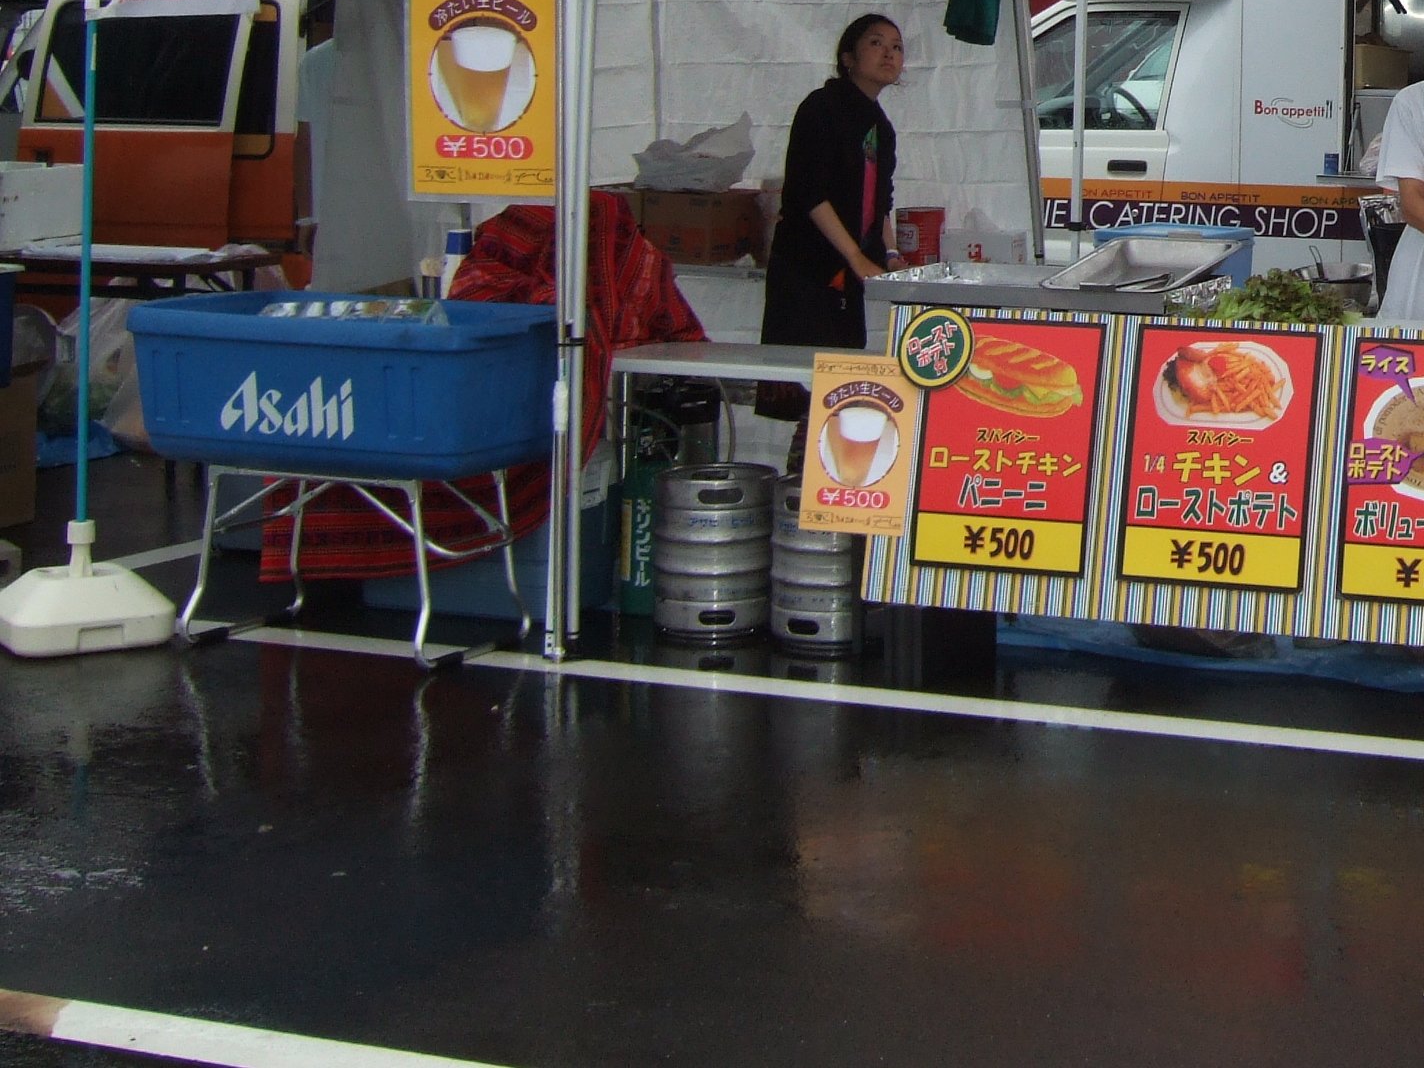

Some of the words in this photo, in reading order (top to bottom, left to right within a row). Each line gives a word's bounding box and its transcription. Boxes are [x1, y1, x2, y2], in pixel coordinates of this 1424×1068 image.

[1255, 99, 1278, 115] Bon
[443, 136, 524, 158] ¥500
[1102, 189, 1153, 199] APPETIT
[1181, 191, 1206, 201] BON
[1210, 192, 1260, 203] APPETIT
[1302, 196, 1328, 205] BON
[1254, 207, 1338, 238] SHOP
[907, 321, 957, 355] ロースト
[1360, 354, 1410, 373] ライス
[219, 370, 354, 441] Asahi
[828, 382, 900, 409] 冷たい生ビール
[976, 427, 1040, 444] スパイシー
[1187, 430, 1253, 446] スパイシー
[929, 446, 1082, 477] ローストチキン
[1350, 442, 1408, 461] ロースト
[1143, 454, 1166, 473] 1/4
[1172, 451, 1261, 486] チキン
[1269, 462, 1288, 484] &
[823, 490, 883, 507] ¥500
[958, 473, 1046, 511] パニーニ
[1135, 485, 1297, 530] ローストポテト
[964, 525, 1035, 560] ¥500
[1170, 539, 1245, 575] ¥500
